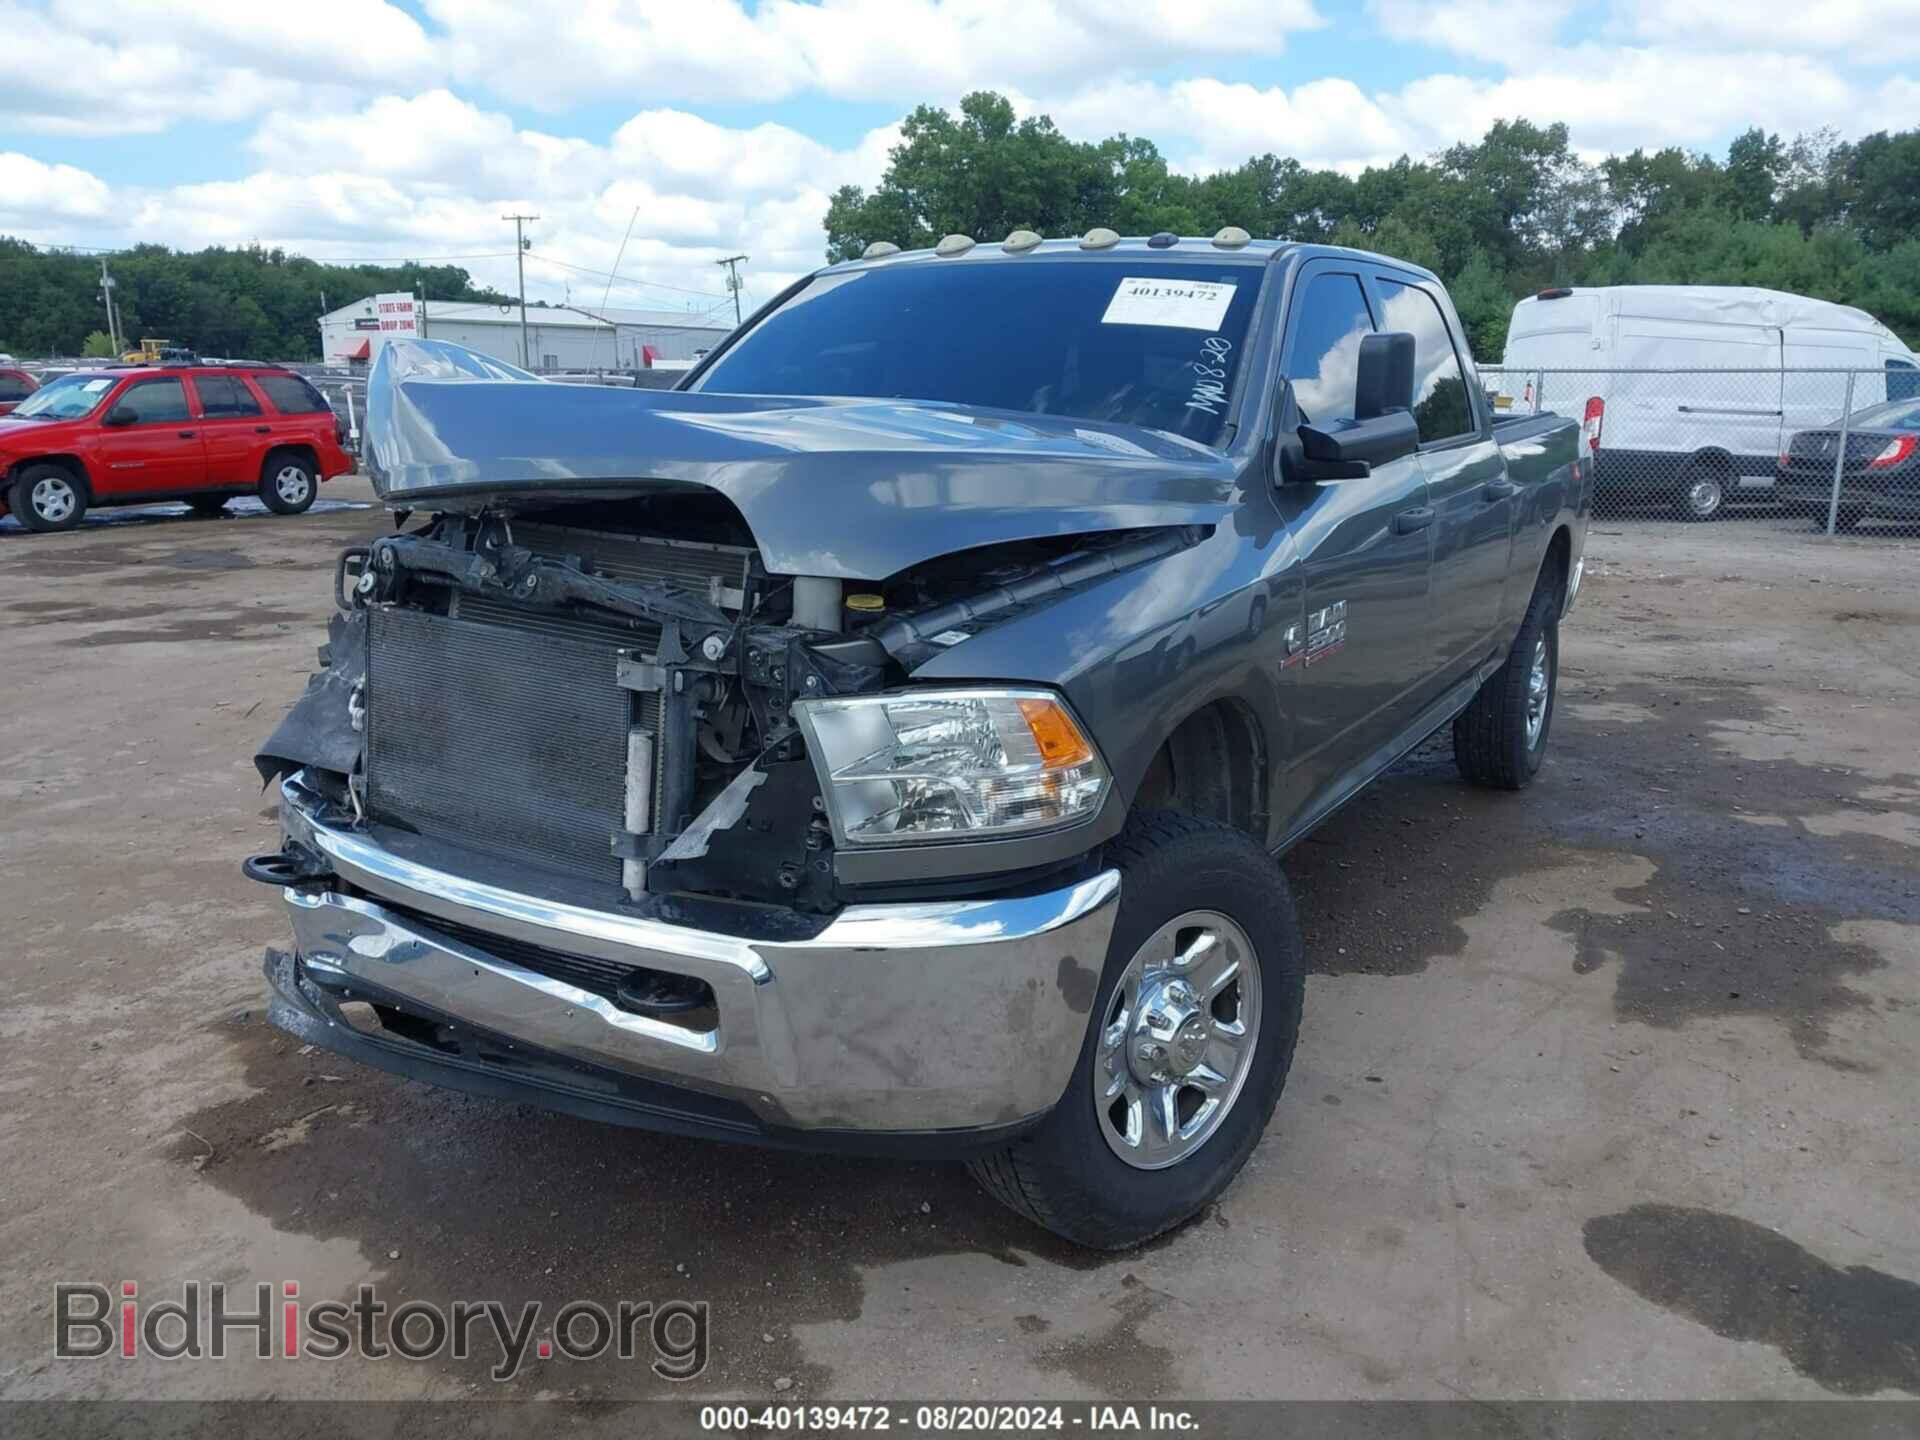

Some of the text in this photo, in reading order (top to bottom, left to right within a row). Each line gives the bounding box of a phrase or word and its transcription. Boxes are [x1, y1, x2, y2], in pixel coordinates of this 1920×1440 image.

[1128, 287, 1217, 301] 40139472
[379, 302, 413, 313] STATE FARM
[381, 320, 398, 330] DROP
[400, 320, 415, 330] ZONE
